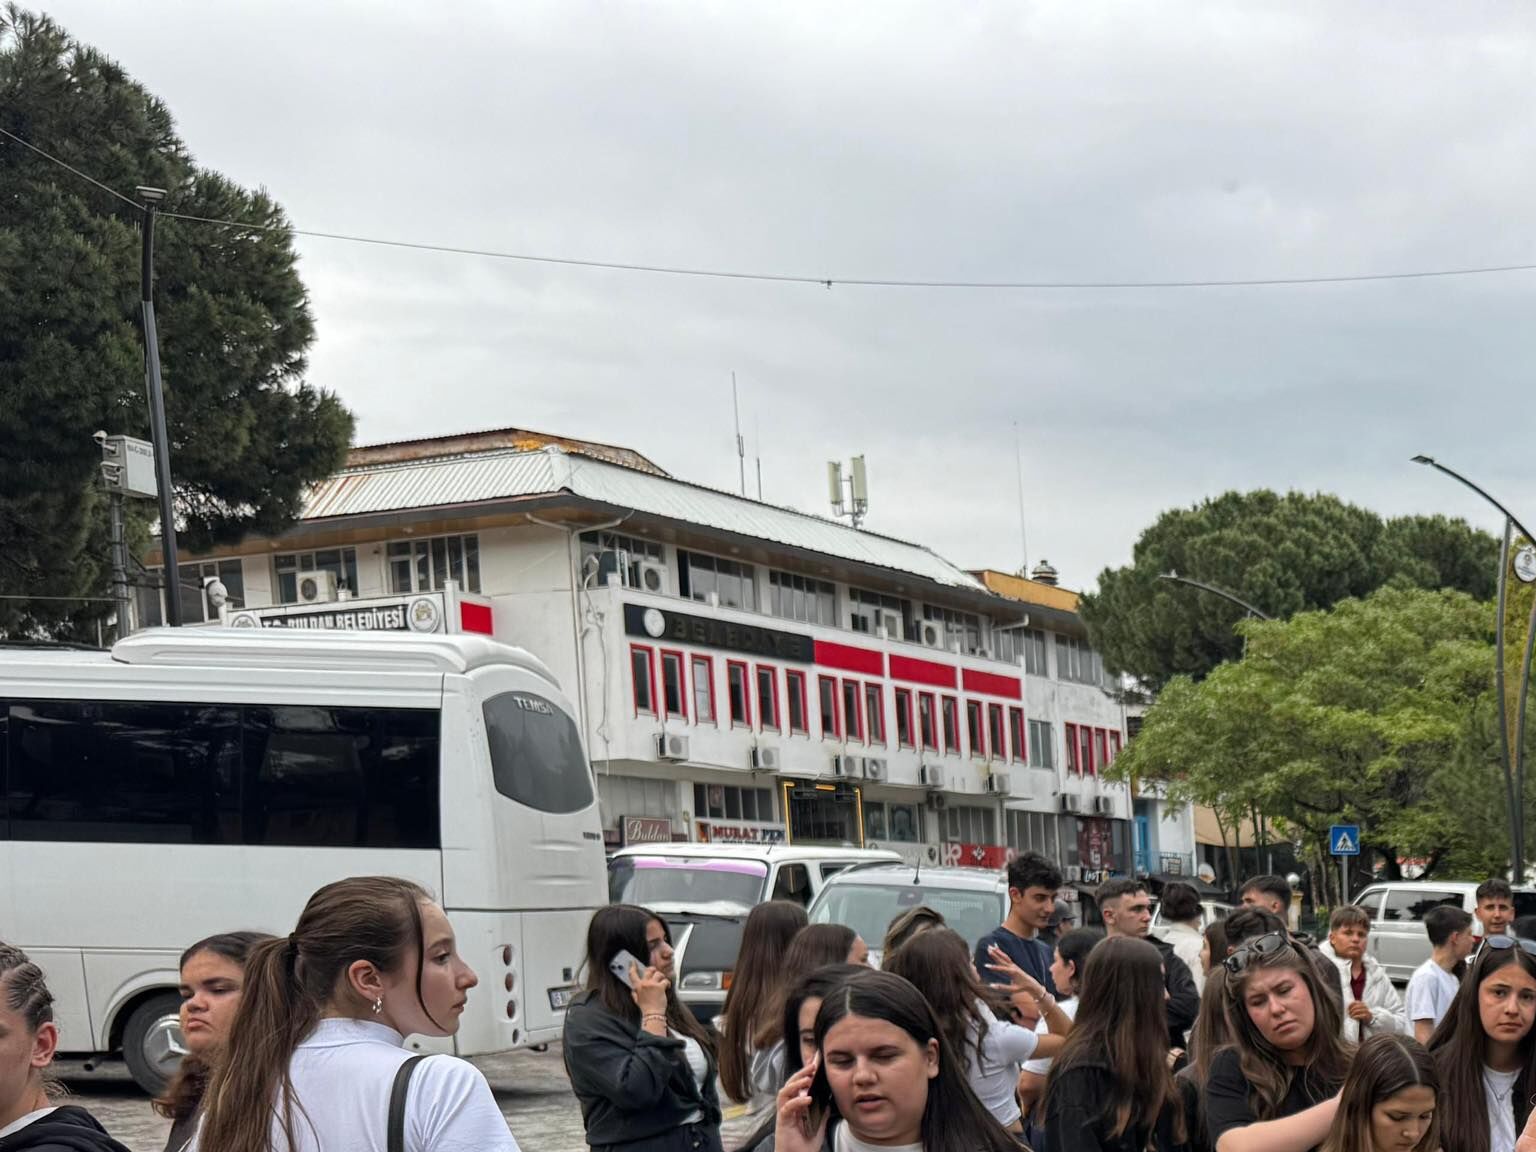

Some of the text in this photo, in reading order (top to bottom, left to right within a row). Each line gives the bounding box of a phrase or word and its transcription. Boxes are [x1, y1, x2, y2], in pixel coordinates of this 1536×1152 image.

[335, 605, 406, 631] BELEDİYESİ
[513, 696, 554, 714] TEMSA
[627, 820, 670, 841] Buldan
[713, 825, 759, 840] MURAT
